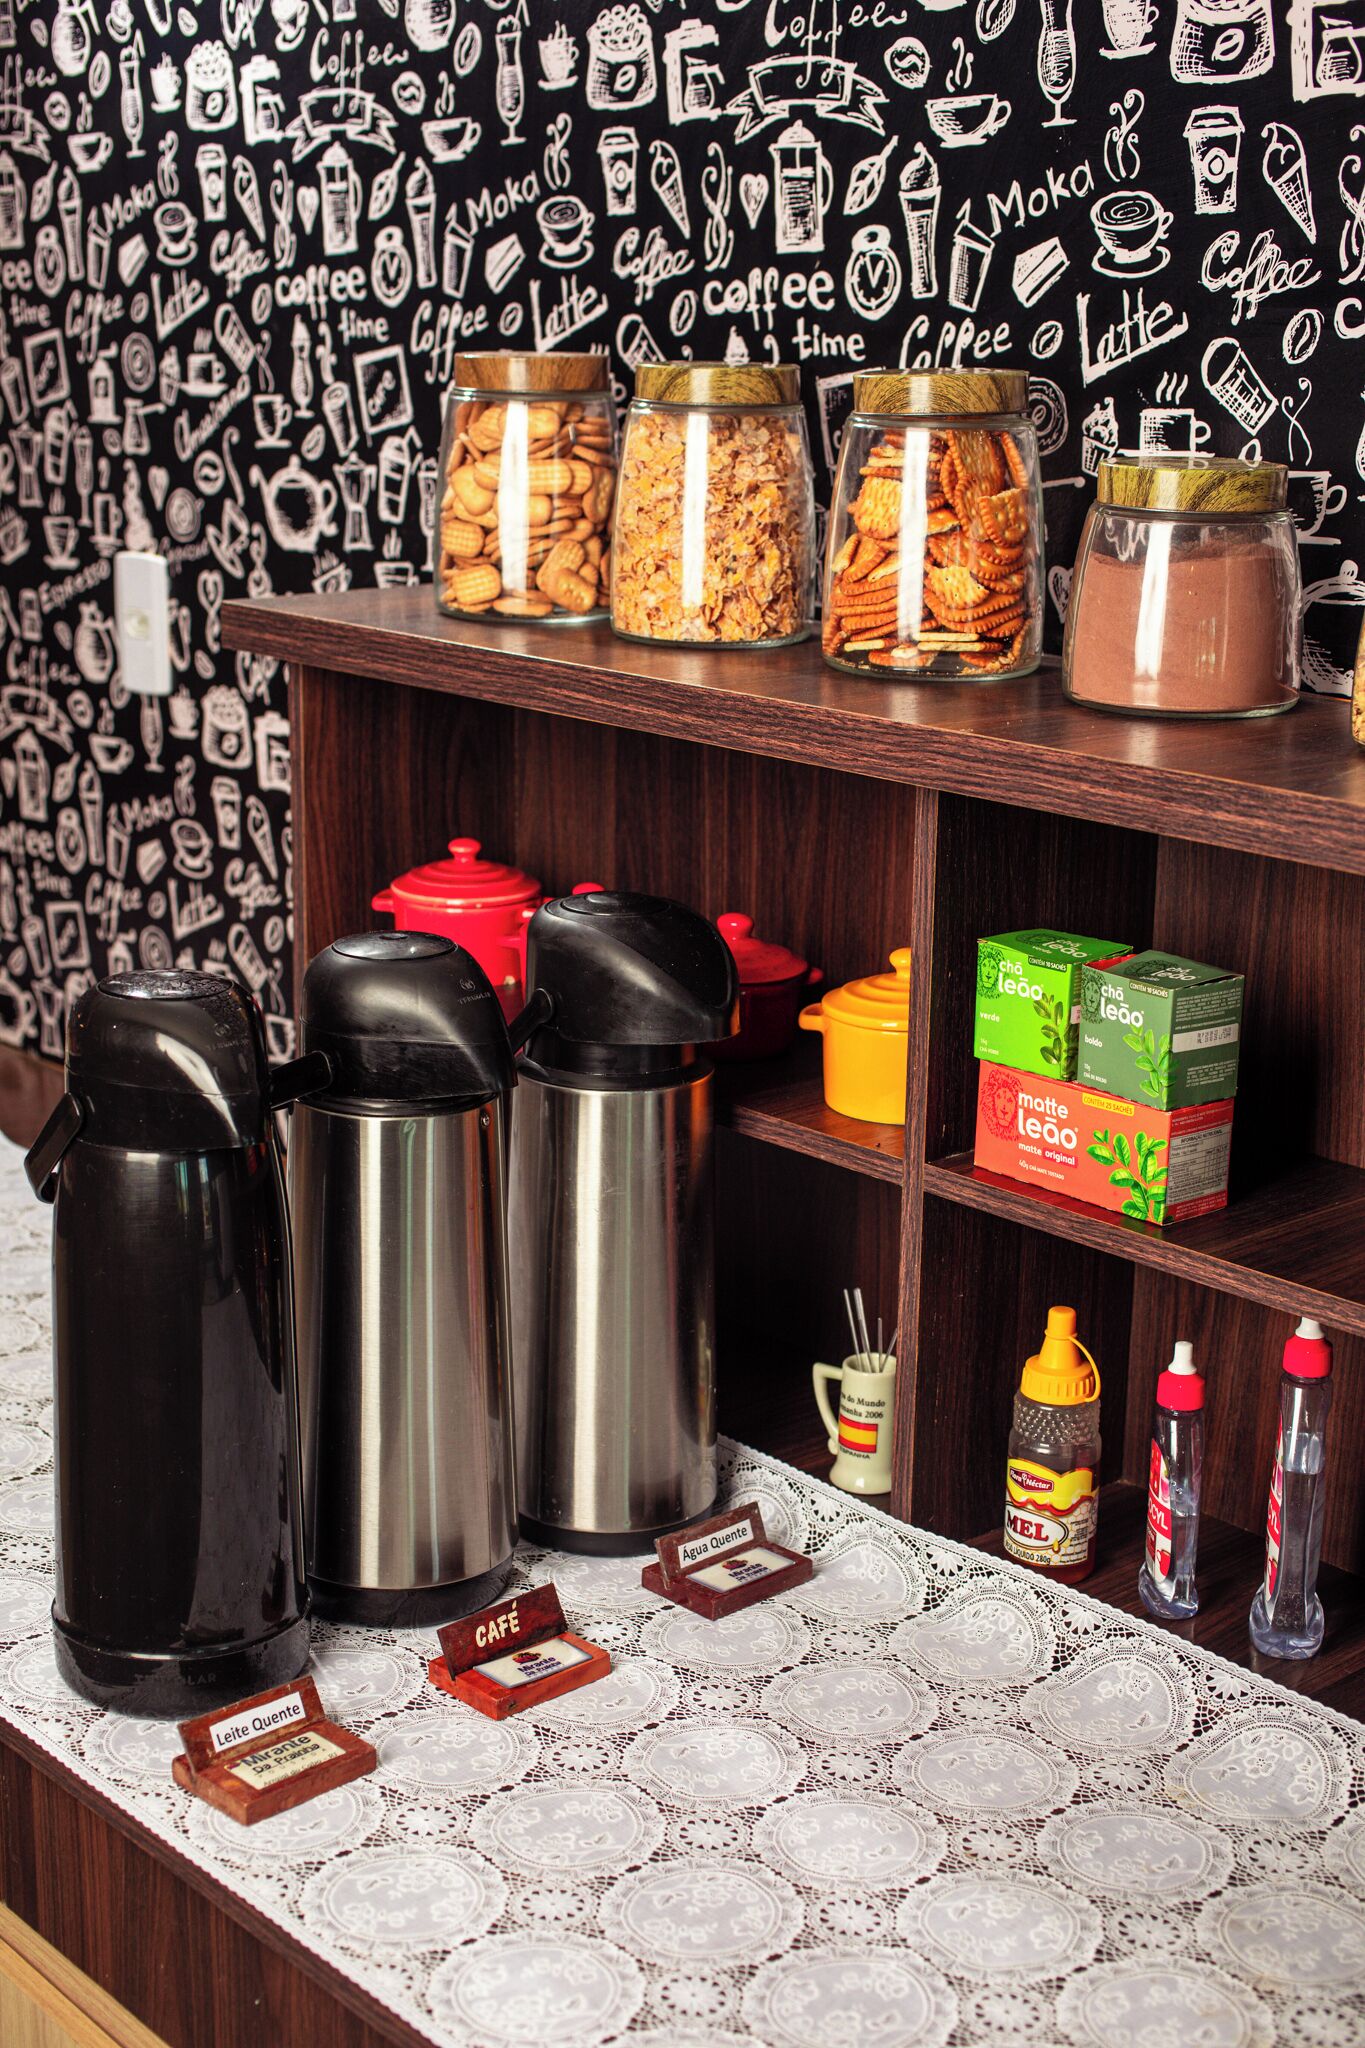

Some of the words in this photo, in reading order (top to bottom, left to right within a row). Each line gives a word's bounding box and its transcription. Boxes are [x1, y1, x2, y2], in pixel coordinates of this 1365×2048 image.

[102, 180, 157, 235] Moka
[467, 170, 540, 235] Moka
[988, 160, 1094, 237] Moka
[209, 230, 270, 297] Coffee
[612, 226, 695, 305] Coffee
[1199, 230, 1322, 325] Coffee
[9, 293, 51, 329] time
[150, 269, 210, 340] Latte
[275, 265, 367, 319] coffee
[529, 274, 608, 352] Latte
[703, 267, 835, 331] coffee
[338, 307, 390, 345] time
[410, 300, 488, 384] Coffee
[791, 317, 867, 362] time
[1076, 288, 1188, 388] Latte
[123, 794, 175, 834] Moka
[167, 878, 225, 941] Latte
[980, 1011, 1000, 1023] verde
[1084, 1034, 1103, 1048] boldo
[1018, 1092, 1069, 1119] matte
[1017, 1108, 1078, 1150] leão
[1018, 1143, 1042, 1156] matte
[1044, 1150, 1075, 1165] original
[846, 1394, 855, 1403] do
[857, 1397, 886, 1407] Mundo
[864, 1410, 884, 1419] 2006
[1026, 1477, 1050, 1490] Néctar
[683, 1543, 709, 1561] Água
[710, 1527, 748, 1549] Quente
[1007, 1509, 1049, 1542] MEL
[475, 1600, 520, 1648] CAFÉ
[216, 1725, 250, 1746] Leite
[252, 1704, 301, 1731] Quente
[240, 1736, 311, 1767] Mirante
[252, 1763, 272, 1774] Da
